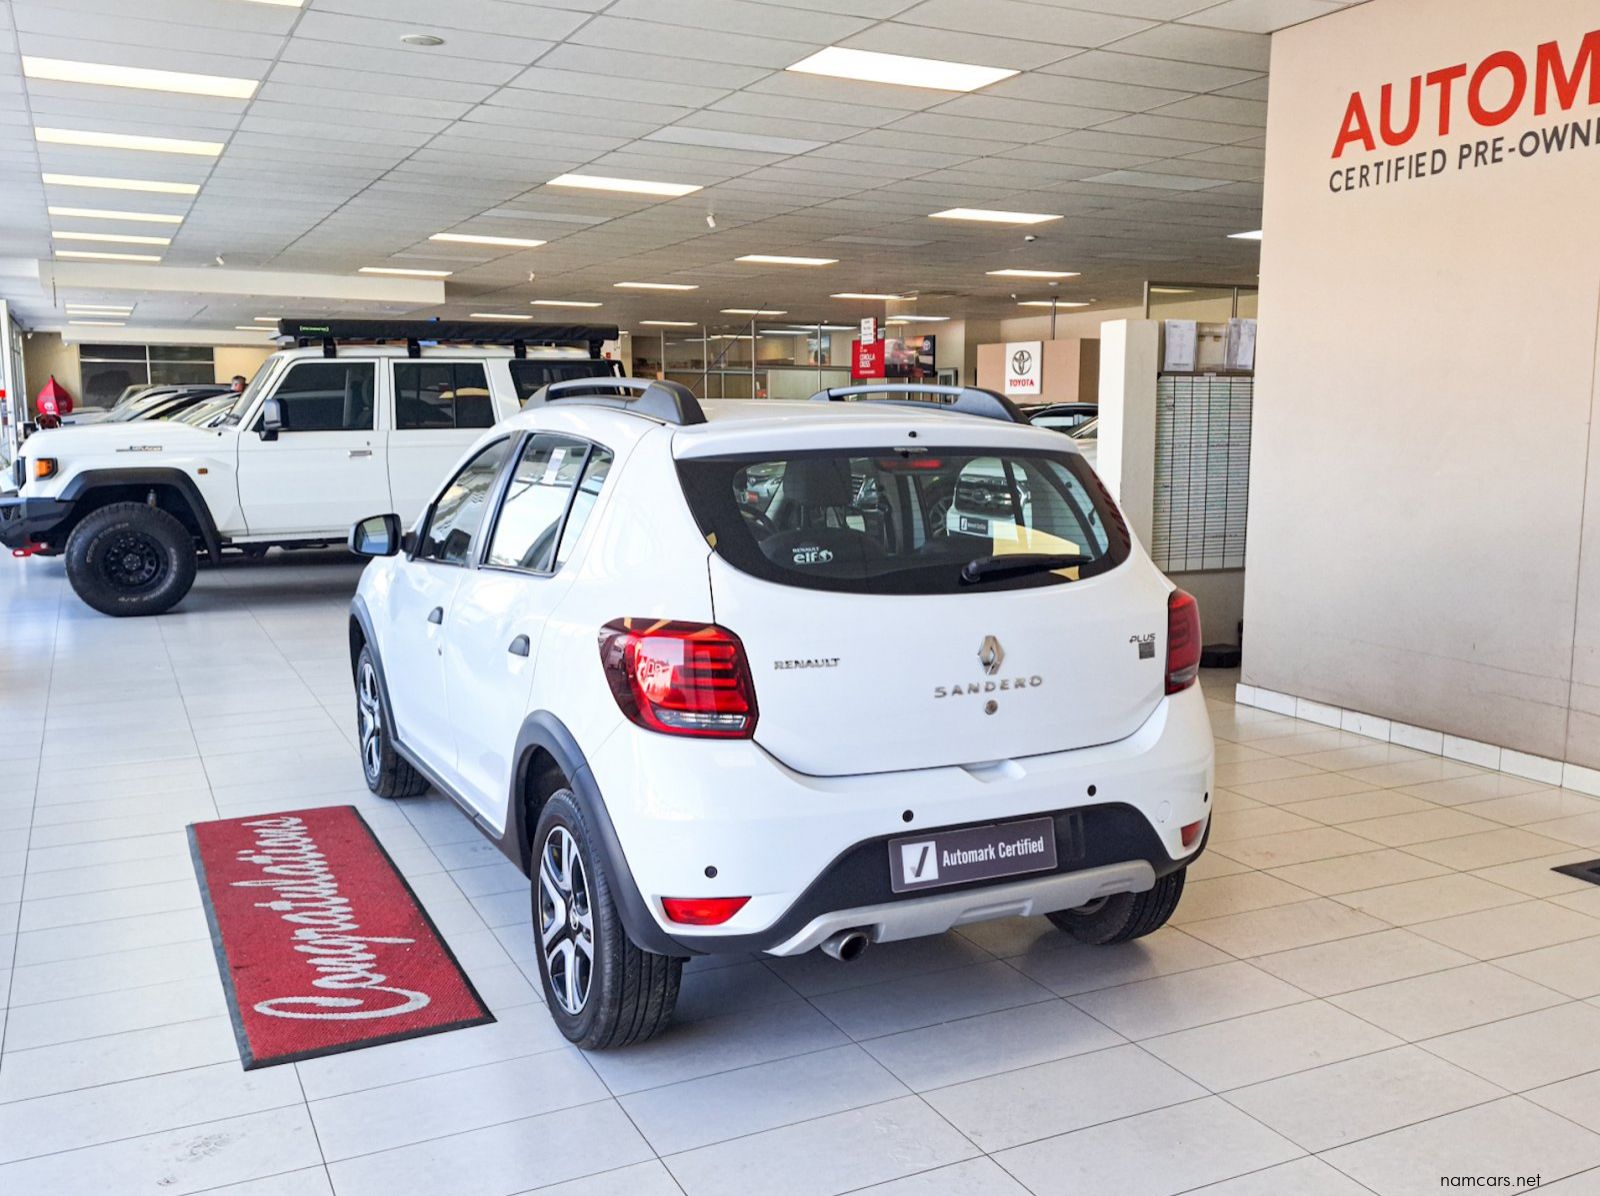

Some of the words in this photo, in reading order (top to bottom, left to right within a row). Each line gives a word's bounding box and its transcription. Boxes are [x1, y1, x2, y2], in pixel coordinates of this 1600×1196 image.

[1329, 149, 1447, 193] CERTIFIED
[1009, 378, 1035, 387] TOYOTA
[793, 551, 818, 564] elf
[1129, 632, 1155, 643] PLUS
[773, 656, 841, 671] RENAULT
[934, 675, 1043, 698] SANDERO
[942, 843, 996, 867] Automark
[998, 837, 1044, 858] Certified
[229, 815, 432, 1021] Congratulations
